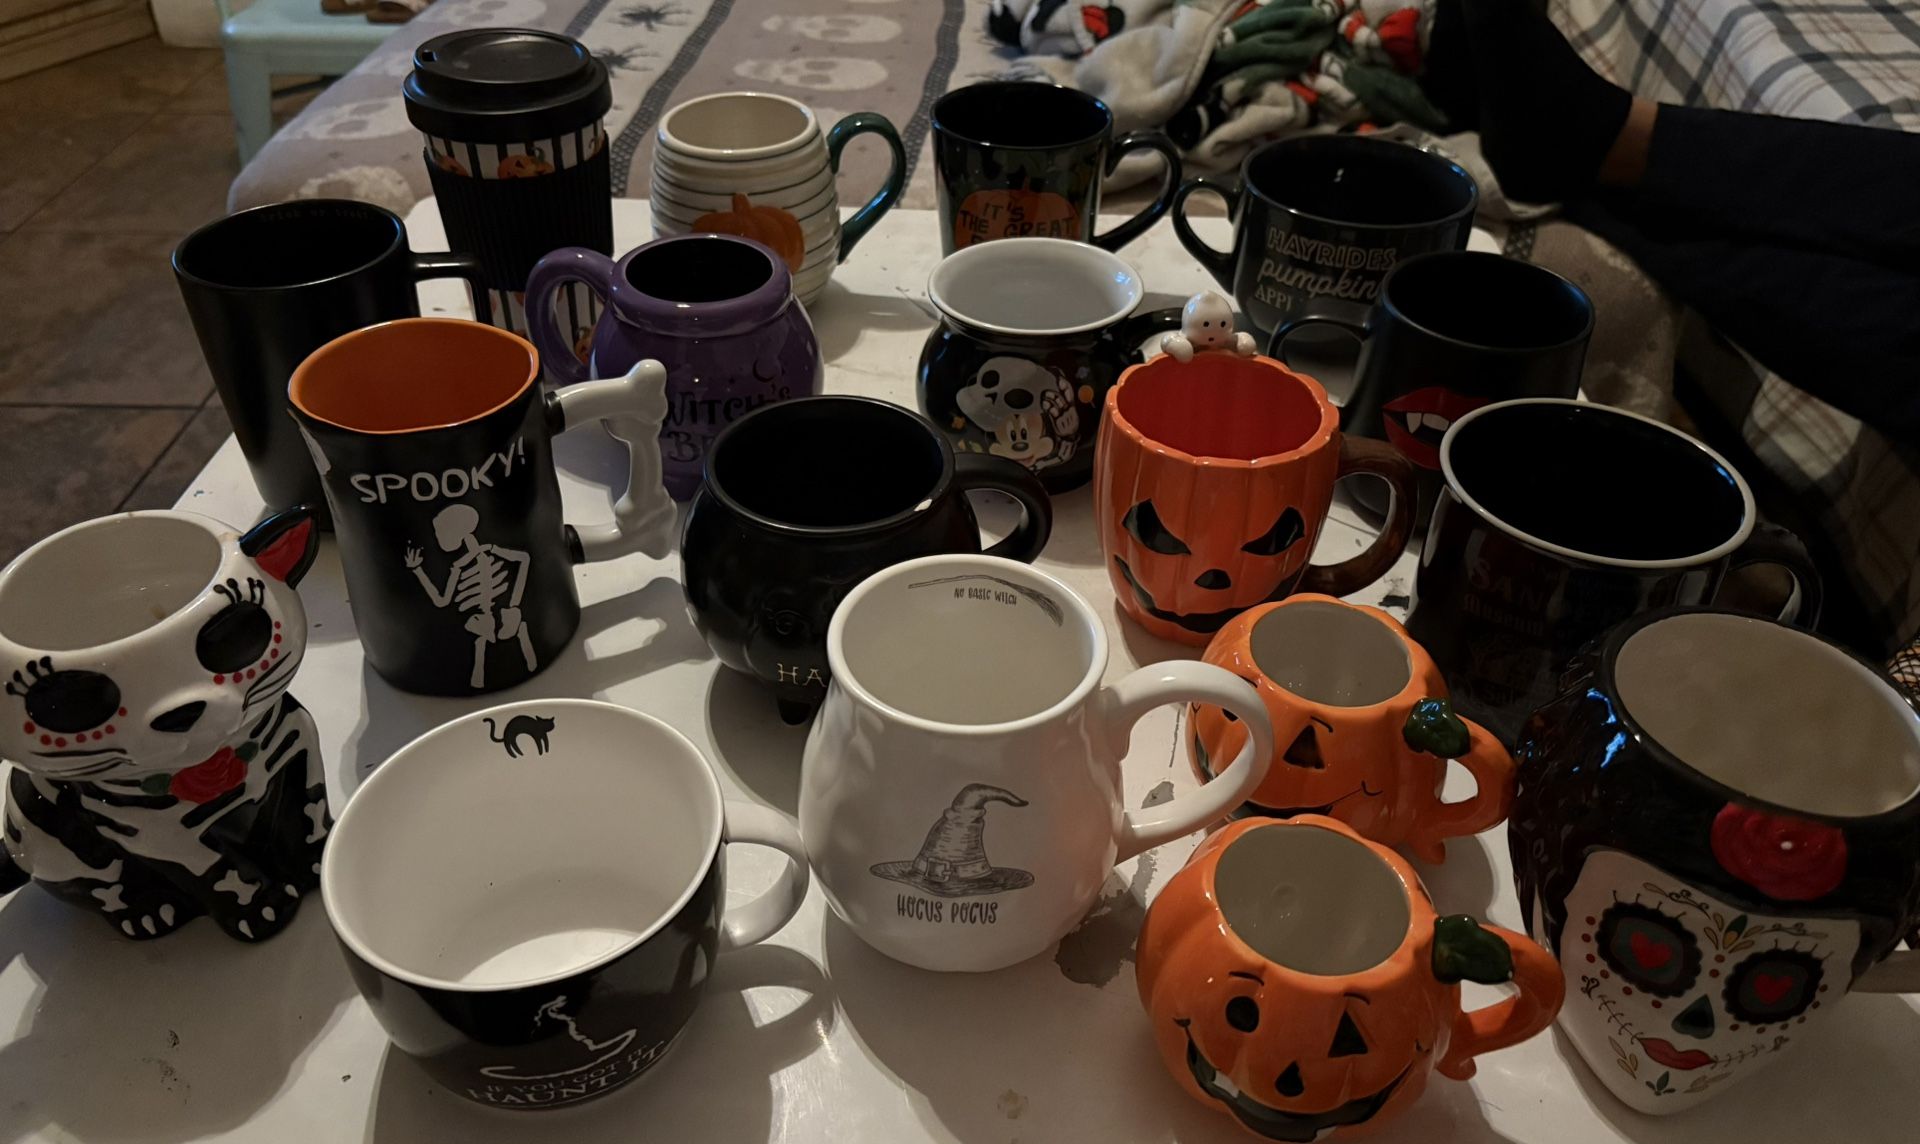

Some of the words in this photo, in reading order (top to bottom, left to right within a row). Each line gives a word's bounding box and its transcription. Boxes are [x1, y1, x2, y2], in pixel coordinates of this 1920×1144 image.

[960, 210, 989, 234] THE
[982, 202, 1025, 222] IT'S
[1266, 226, 1397, 271] HAYRIDES
[350, 435, 527, 504] SPOOKY!
[953, 588, 965, 600] NO
[968, 588, 991, 600] BASIC
[994, 591, 1018, 605] WITCH
[896, 893, 943, 924] HOCUS
[950, 901, 998, 925] POCUS
[466, 1070, 619, 1104] HAUNT
[630, 1040, 666, 1073] IT
[513, 1078, 565, 1093] YOU
[572, 1059, 621, 1084] GOT
